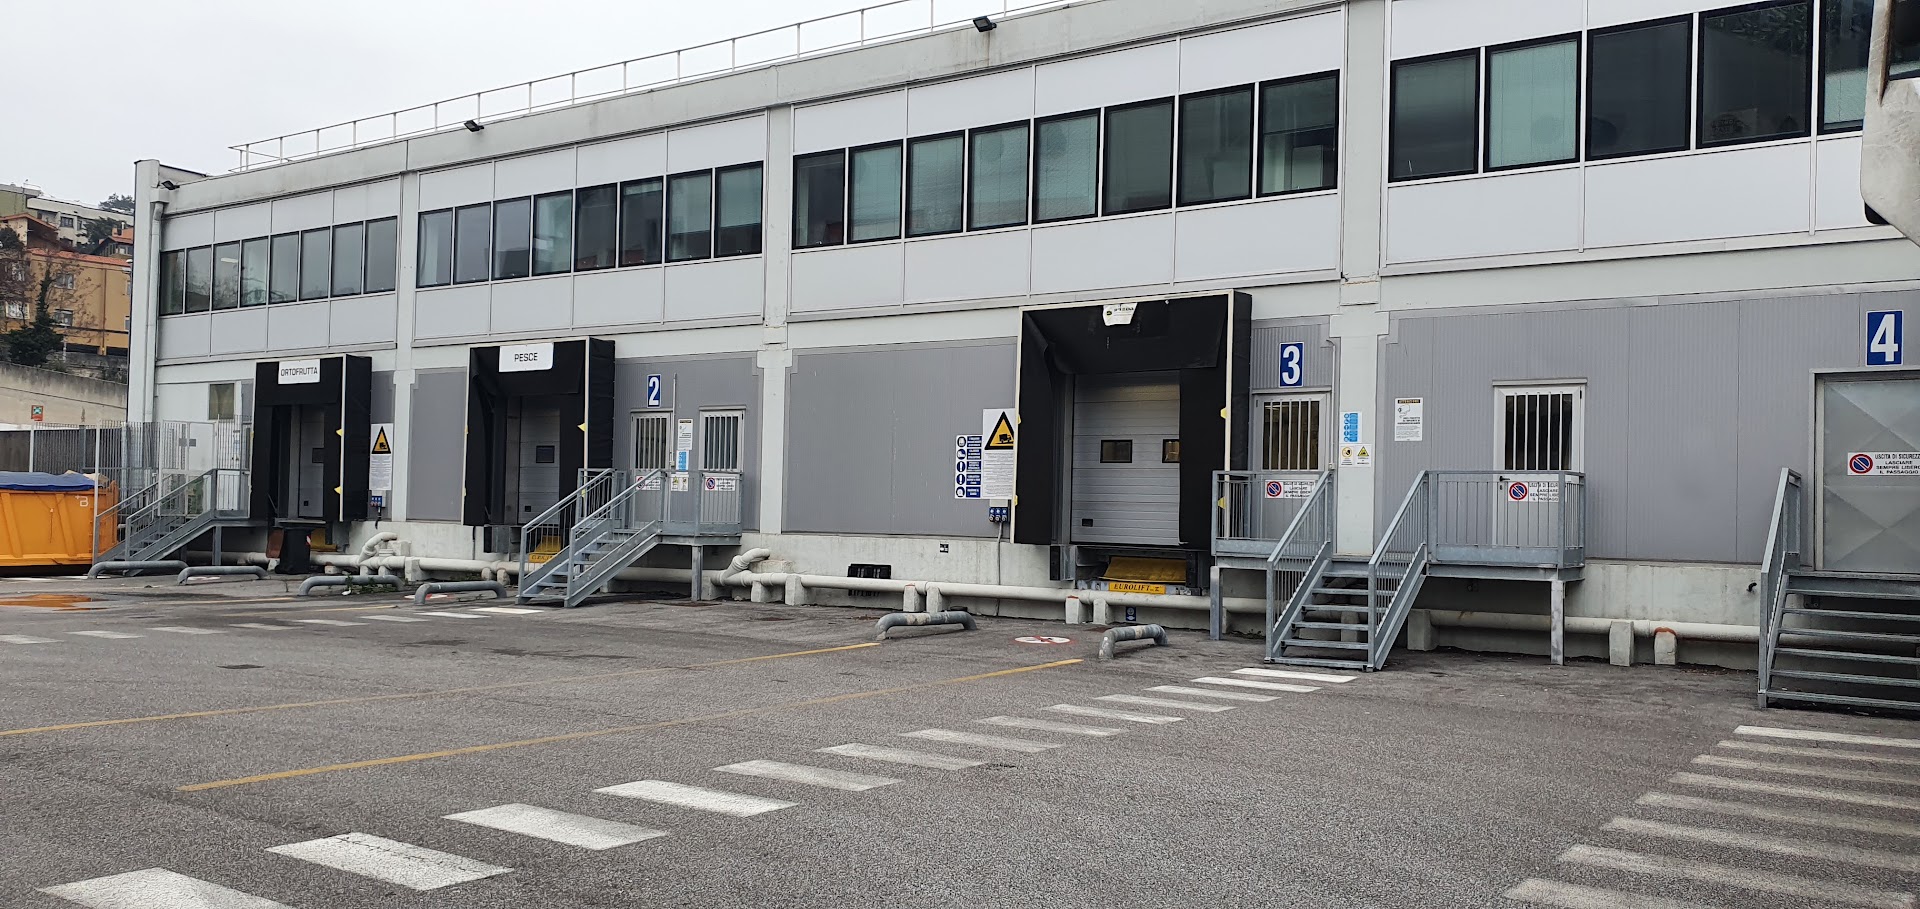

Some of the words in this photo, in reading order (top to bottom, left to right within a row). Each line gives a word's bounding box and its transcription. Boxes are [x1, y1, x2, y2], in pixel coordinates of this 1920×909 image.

[1870, 313, 1899, 362] 4
[514, 352, 538, 362] PESCE
[1282, 345, 1301, 385] 3
[280, 366, 318, 377] ORTOFRUTTA
[648, 376, 660, 406] 2
[1113, 583, 1151, 591] EUROLIFT
